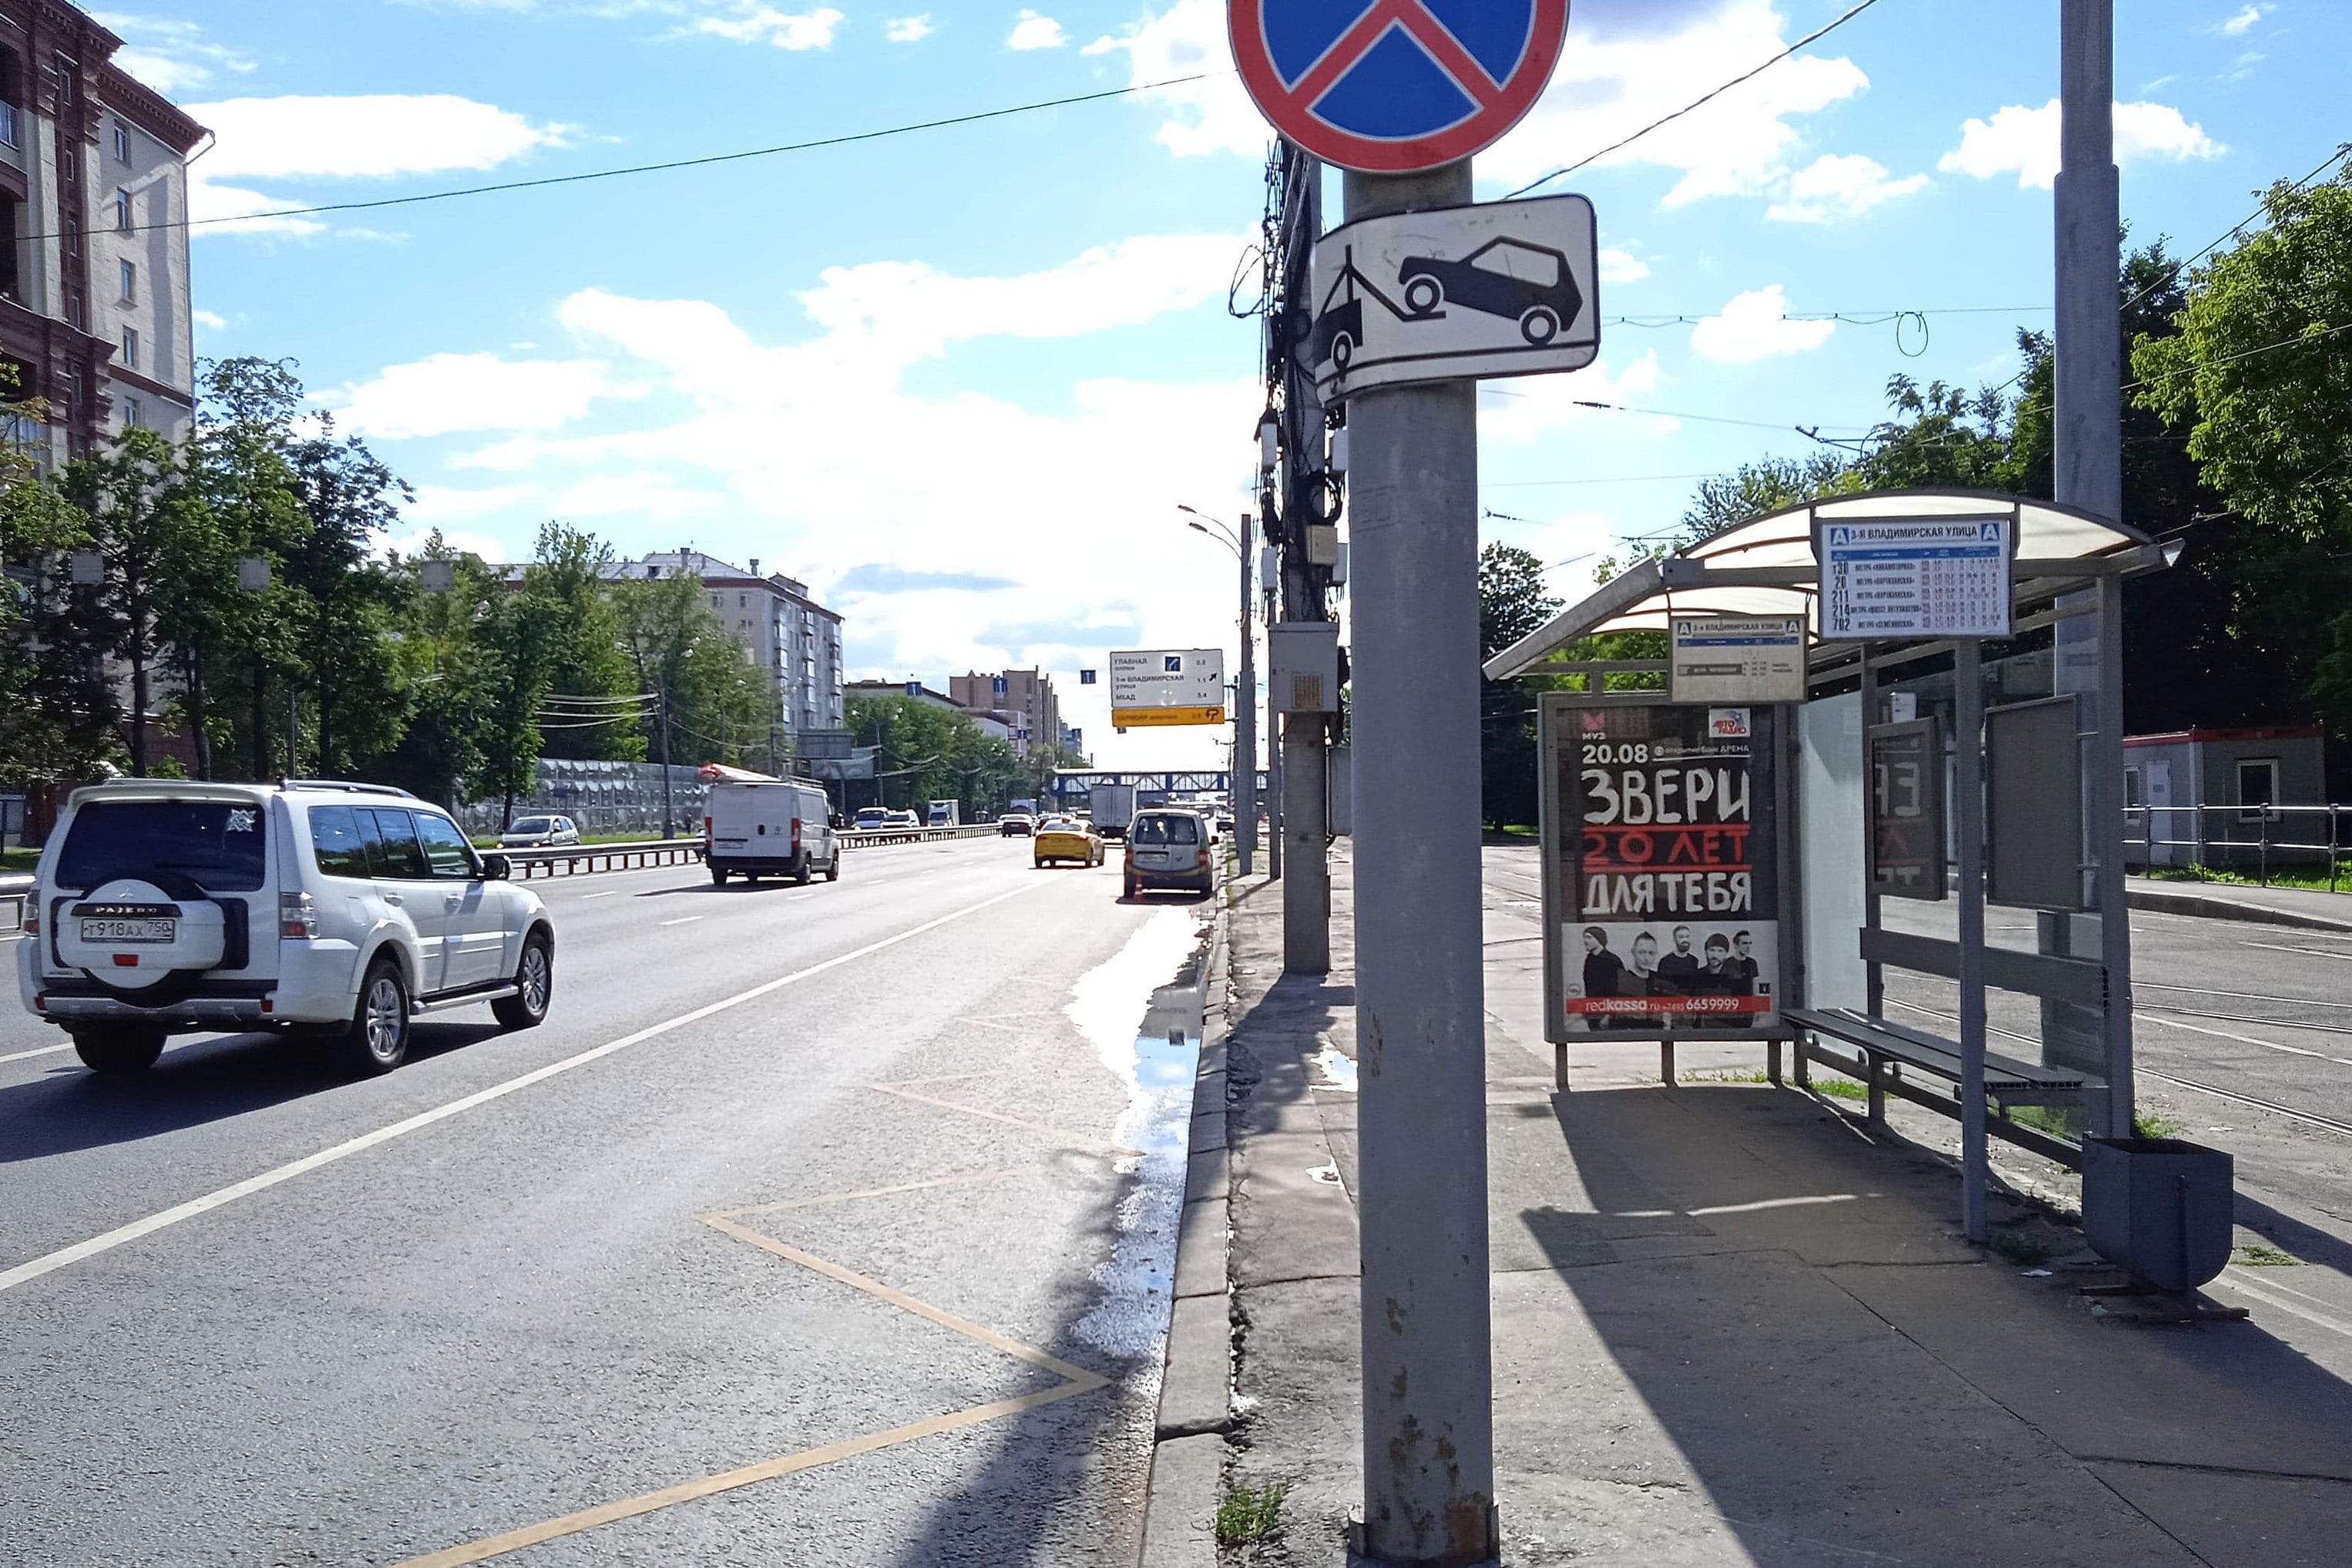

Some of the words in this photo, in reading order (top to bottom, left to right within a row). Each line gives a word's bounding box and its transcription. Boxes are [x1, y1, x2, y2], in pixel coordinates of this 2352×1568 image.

[1868, 527, 1944, 540] ВЛАДИМИРСКАЯ
[1947, 525, 1977, 538] УЛИЦА
[1832, 589, 1849, 603] 211
[1833, 618, 1850, 631] 702
[1582, 732, 1606, 740] МУЗ
[1582, 744, 1648, 764] 20.08
[1581, 767, 1750, 824] ЗВЕРИ
[1583, 831, 1655, 865] 20
[1668, 831, 1749, 864] ЛЕТ
[1582, 873, 1655, 915] ДЛЯ
[1659, 872, 1752, 912] ТЕБЯ
